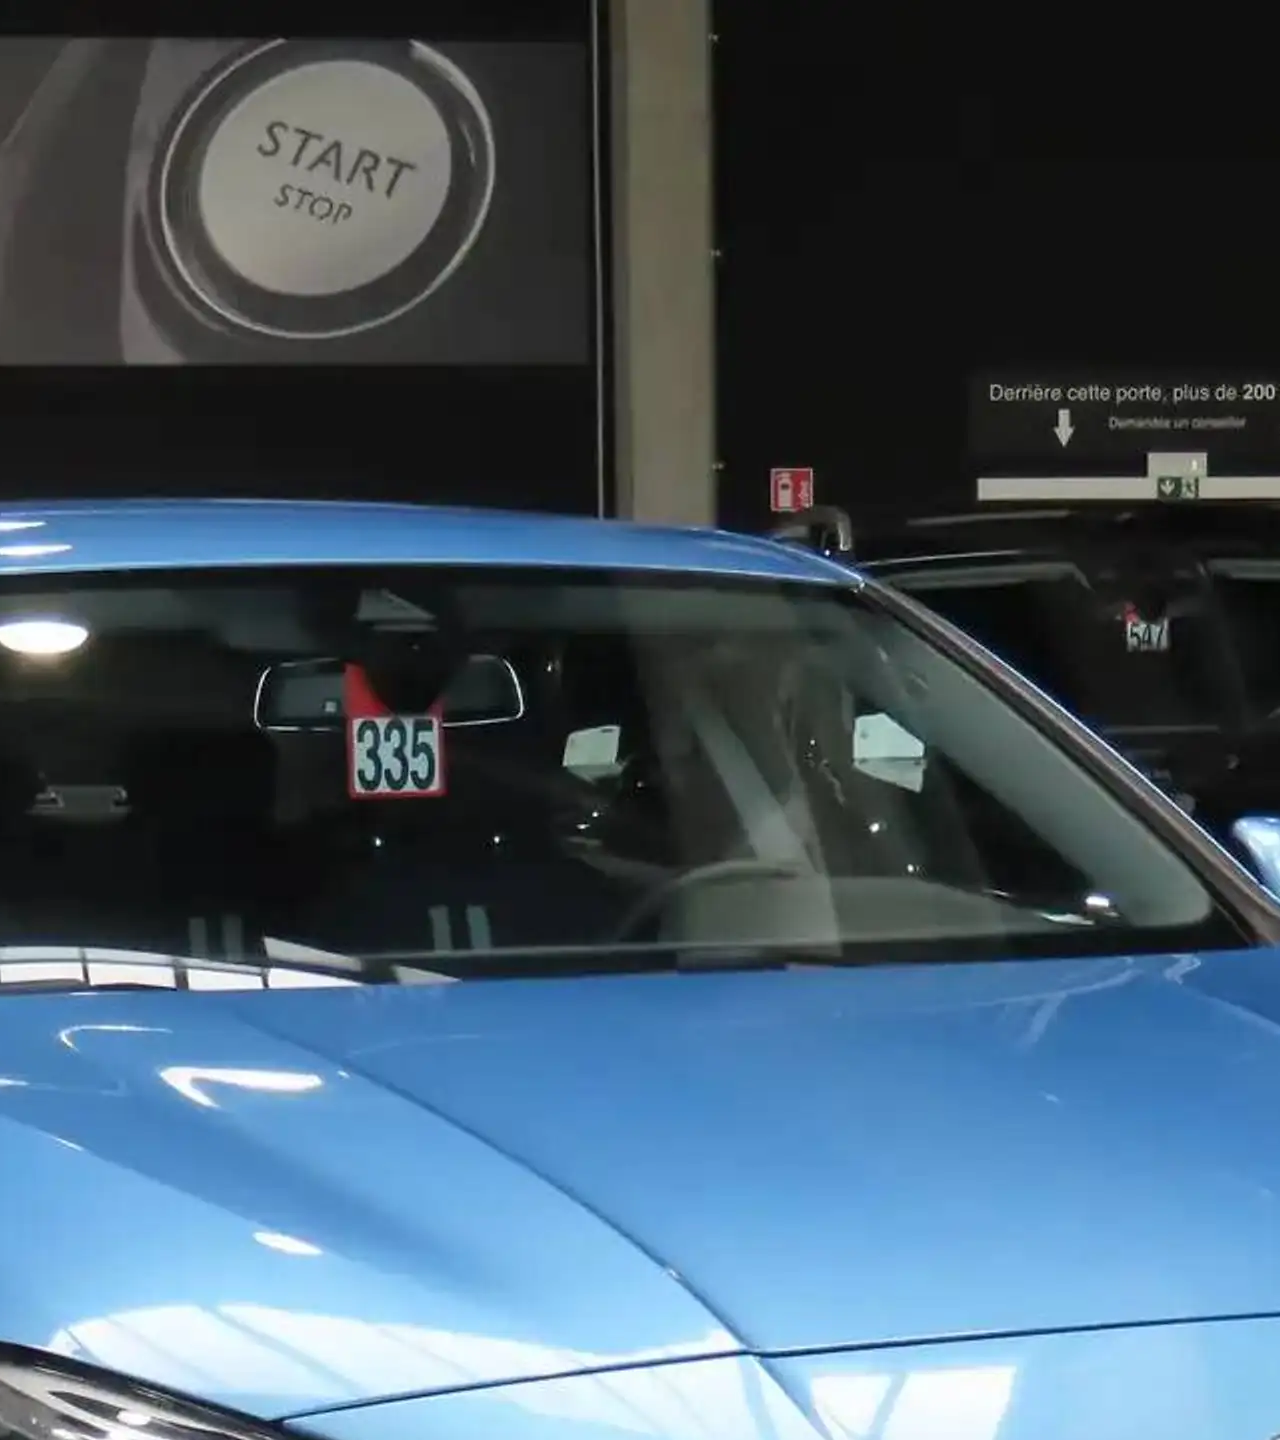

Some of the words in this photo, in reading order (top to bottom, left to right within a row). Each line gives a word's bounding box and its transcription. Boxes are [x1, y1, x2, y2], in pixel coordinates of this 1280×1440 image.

[256, 120, 418, 199] START
[273, 183, 353, 226] STOP
[989, 382, 1062, 401] Derrière
[1067, 385, 1111, 401] cette
[1116, 385, 1167, 405] porte,
[1173, 384, 1209, 404] plus
[1214, 383, 1237, 401] de
[1242, 384, 1275, 400] 200
[356, 719, 437, 792] 335
